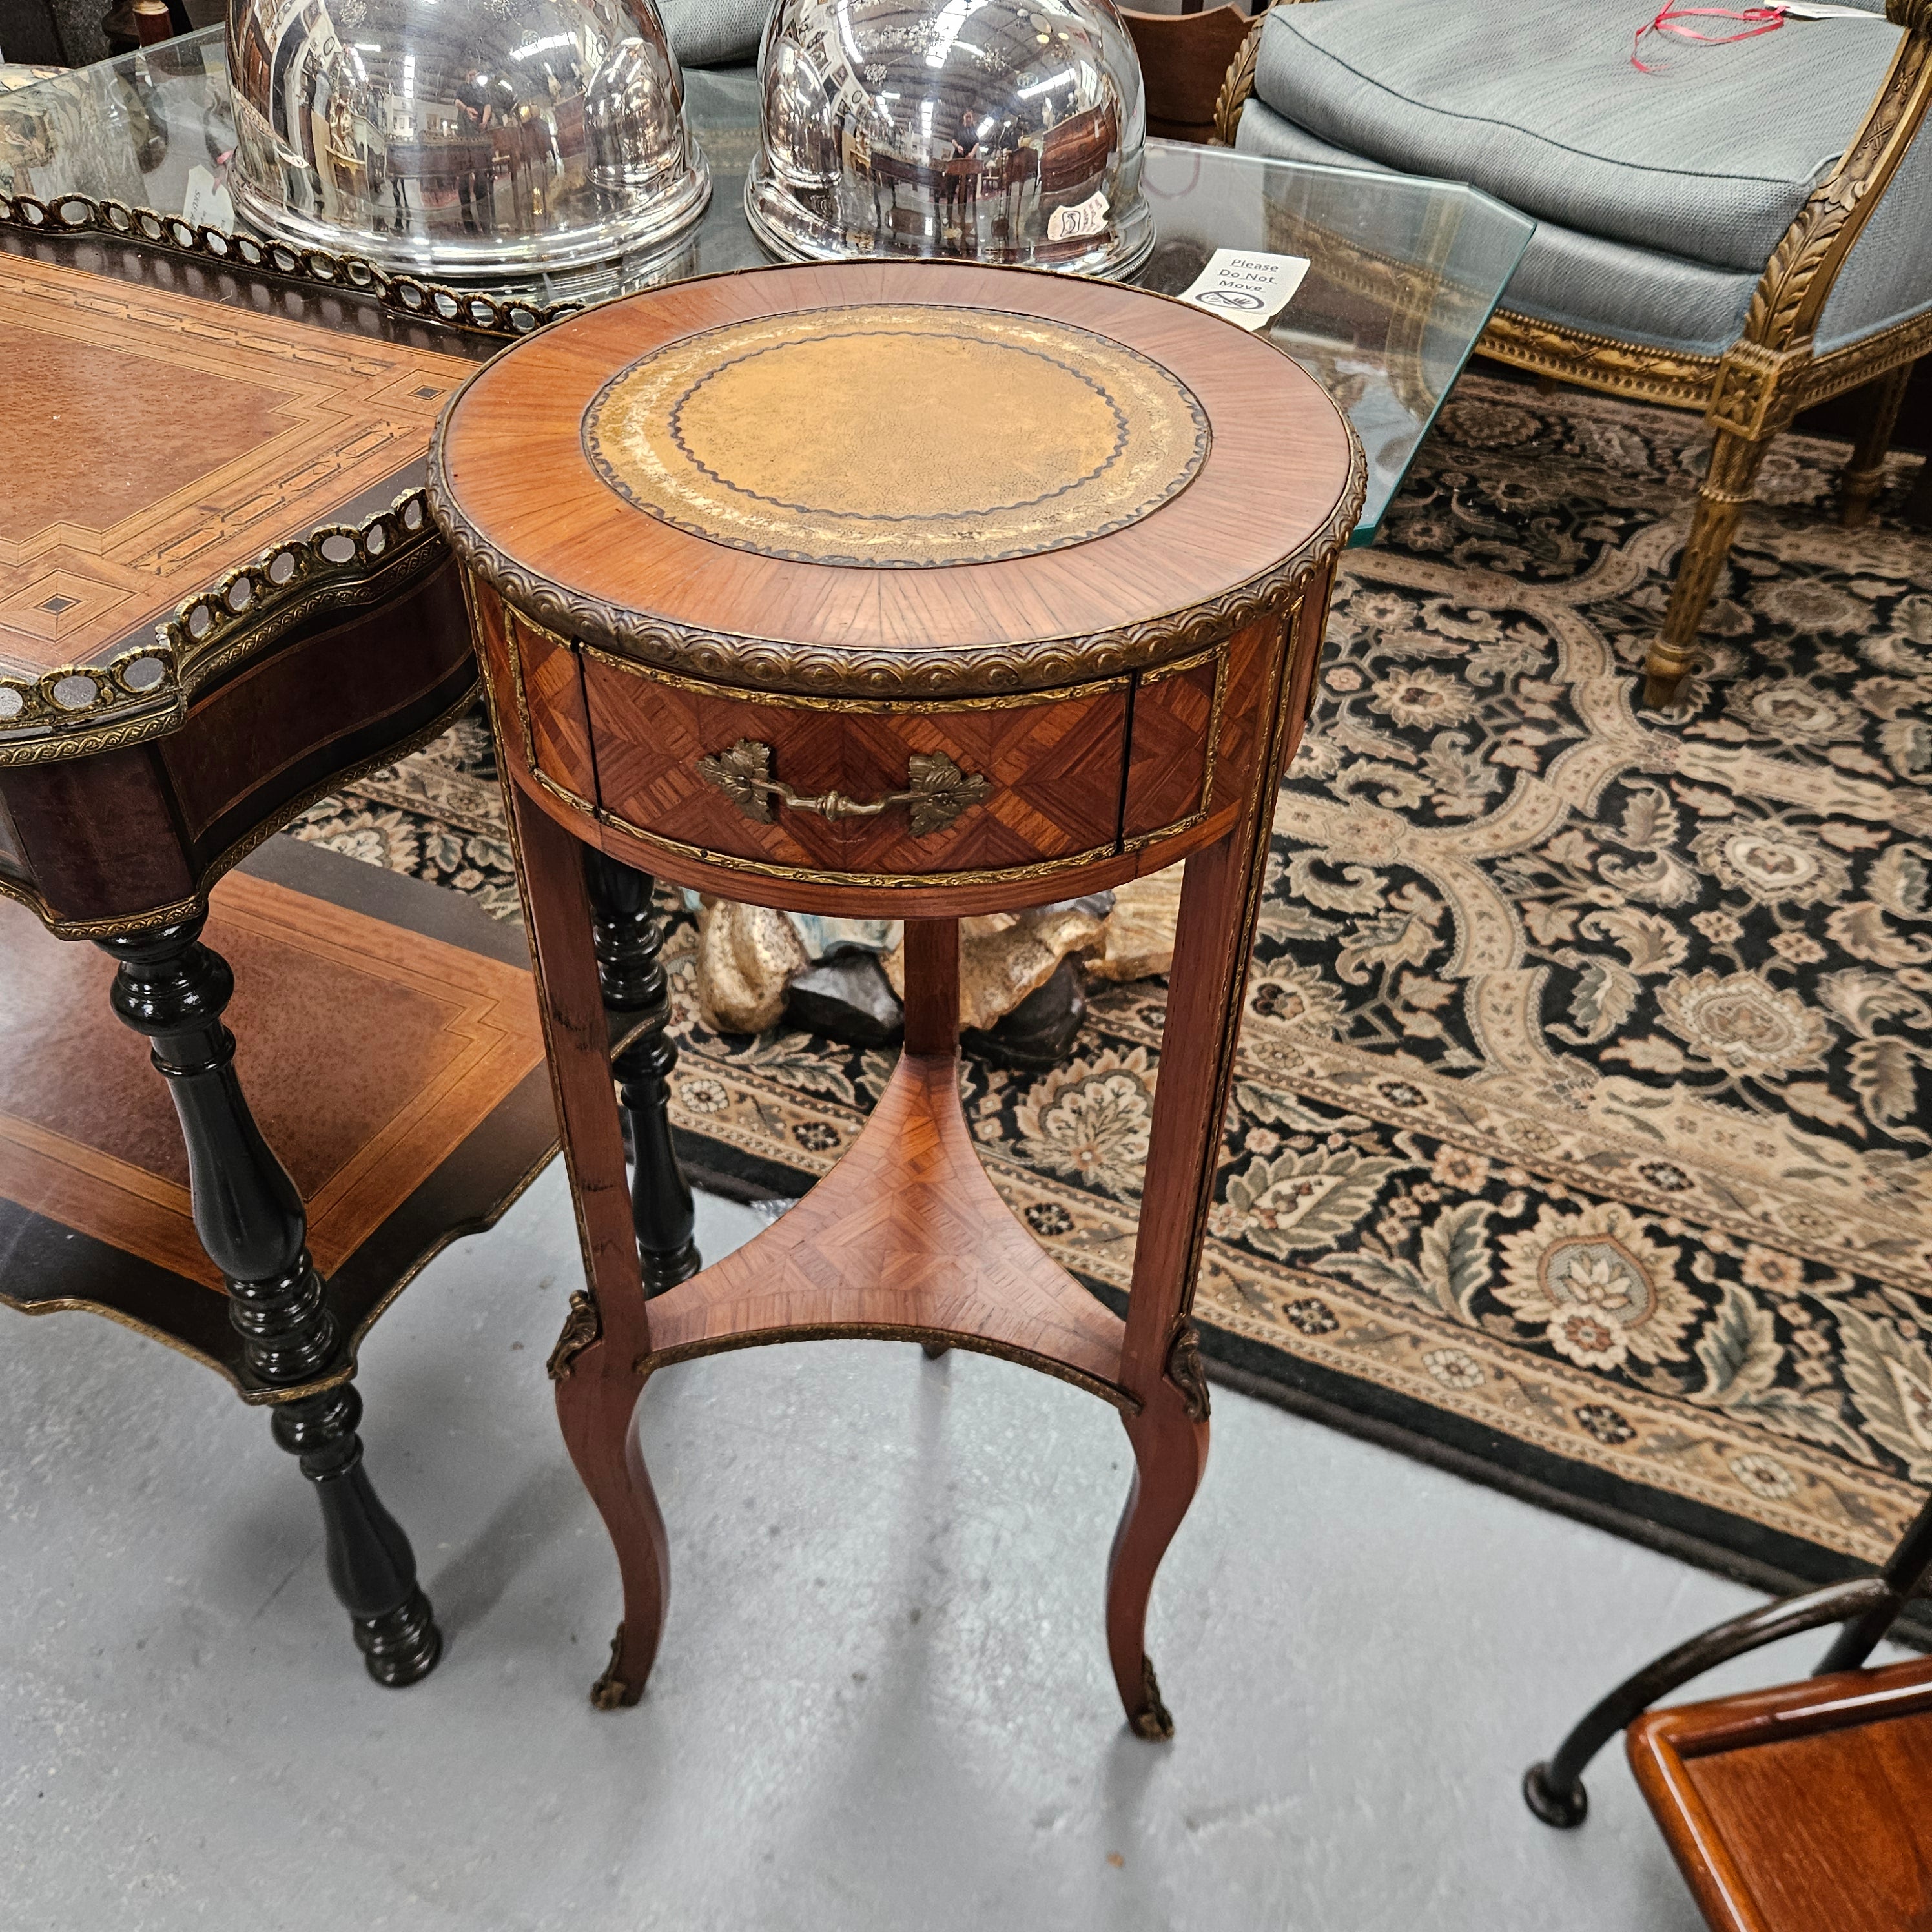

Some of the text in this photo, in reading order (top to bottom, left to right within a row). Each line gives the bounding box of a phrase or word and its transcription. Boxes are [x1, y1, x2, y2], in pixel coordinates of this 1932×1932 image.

[1230, 259, 1279, 272] Please
[1218, 269, 1276, 283] Do Not
[1218, 280, 1263, 291] Move
